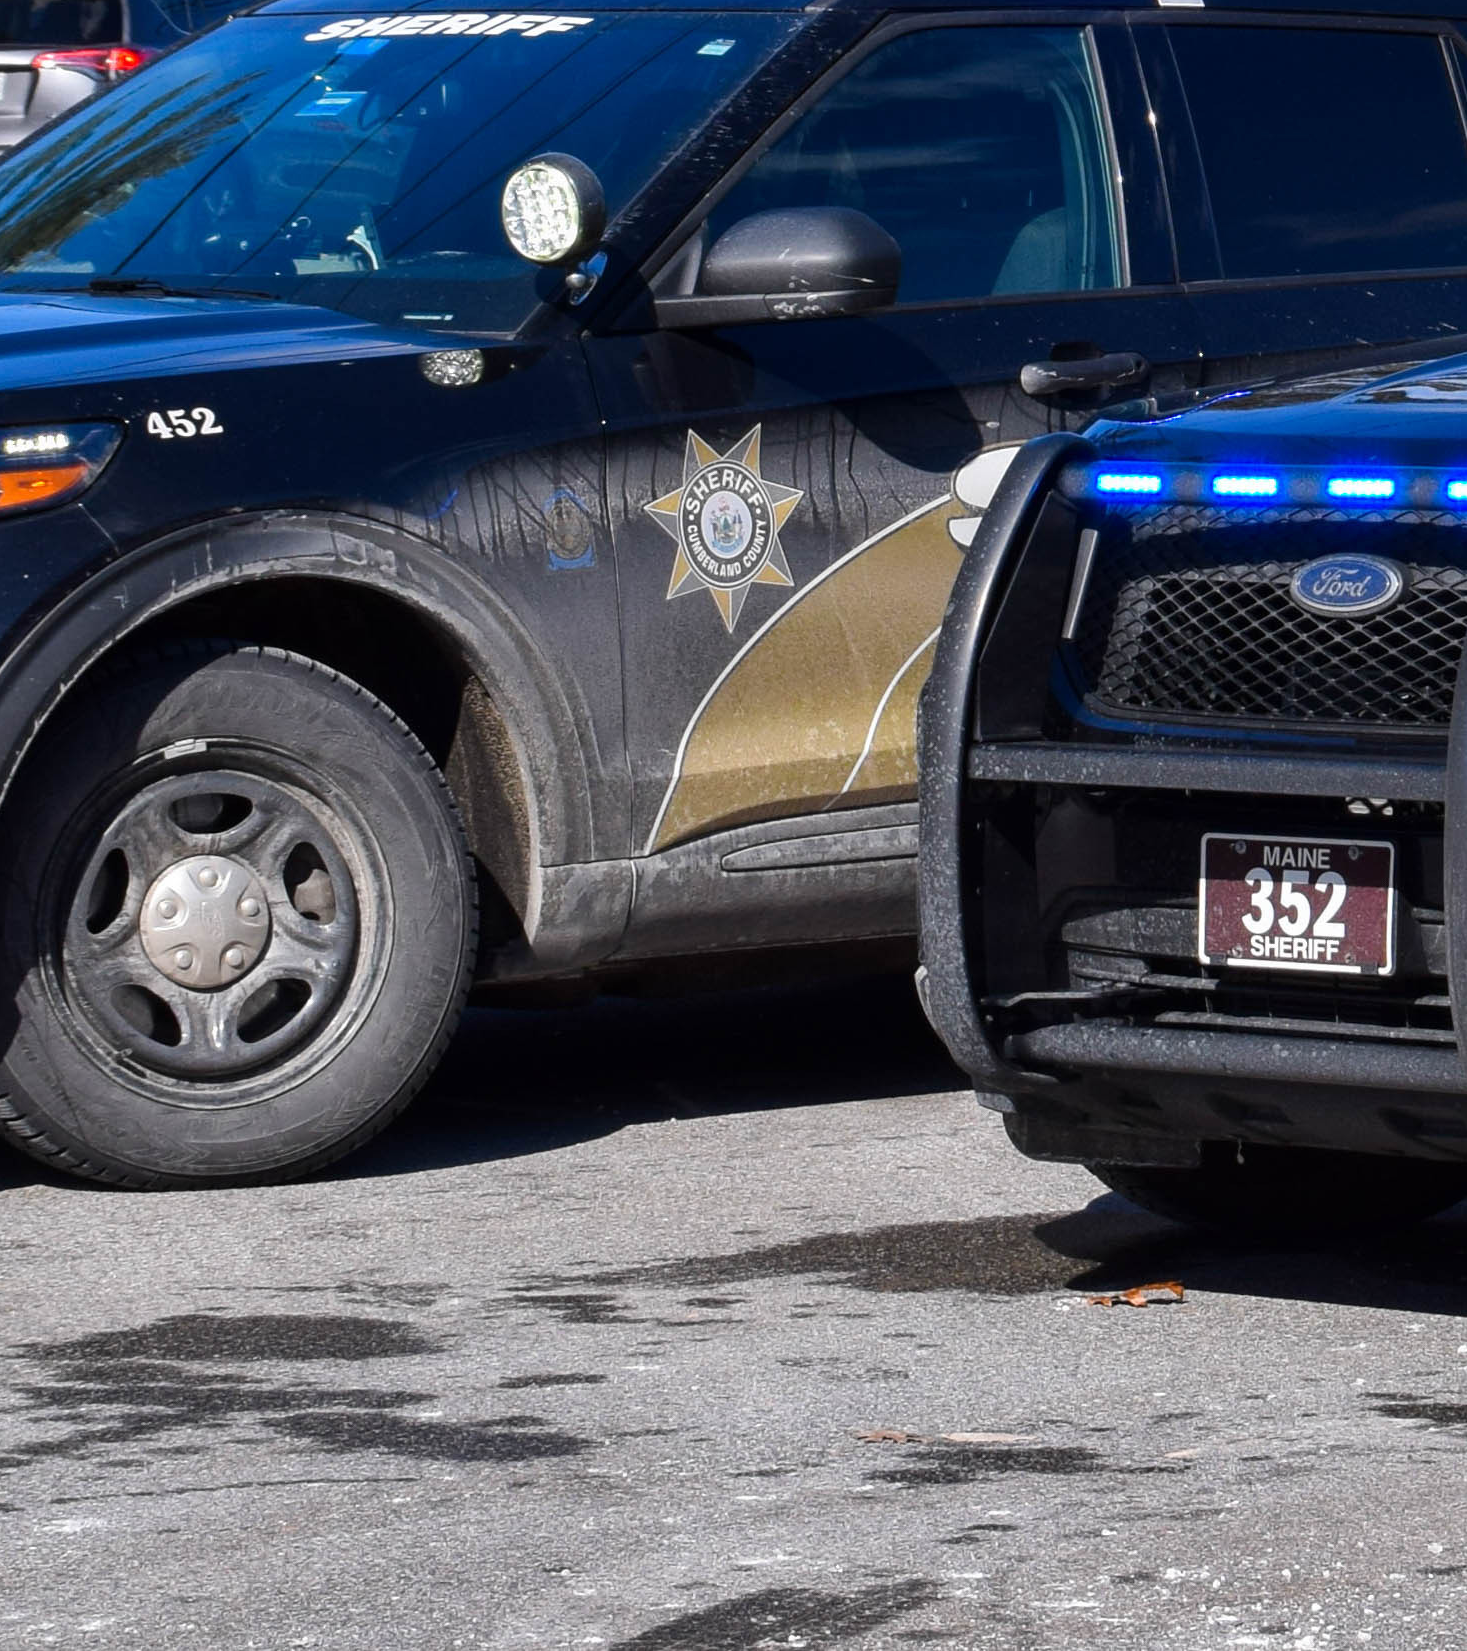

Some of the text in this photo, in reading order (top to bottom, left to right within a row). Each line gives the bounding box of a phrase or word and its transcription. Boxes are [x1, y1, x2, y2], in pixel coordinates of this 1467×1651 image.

[304, 14, 594, 41] SHERIFF
[147, 407, 224, 439] 452
[686, 468, 764, 515] SHERIFF
[687, 519, 767, 577] CUMBERLAND COUNTY
[1313, 566, 1371, 597] Ford
[1263, 846, 1331, 869] MAINE
[1241, 867, 1347, 938] 352
[1250, 935, 1340, 961] SHERIFF
